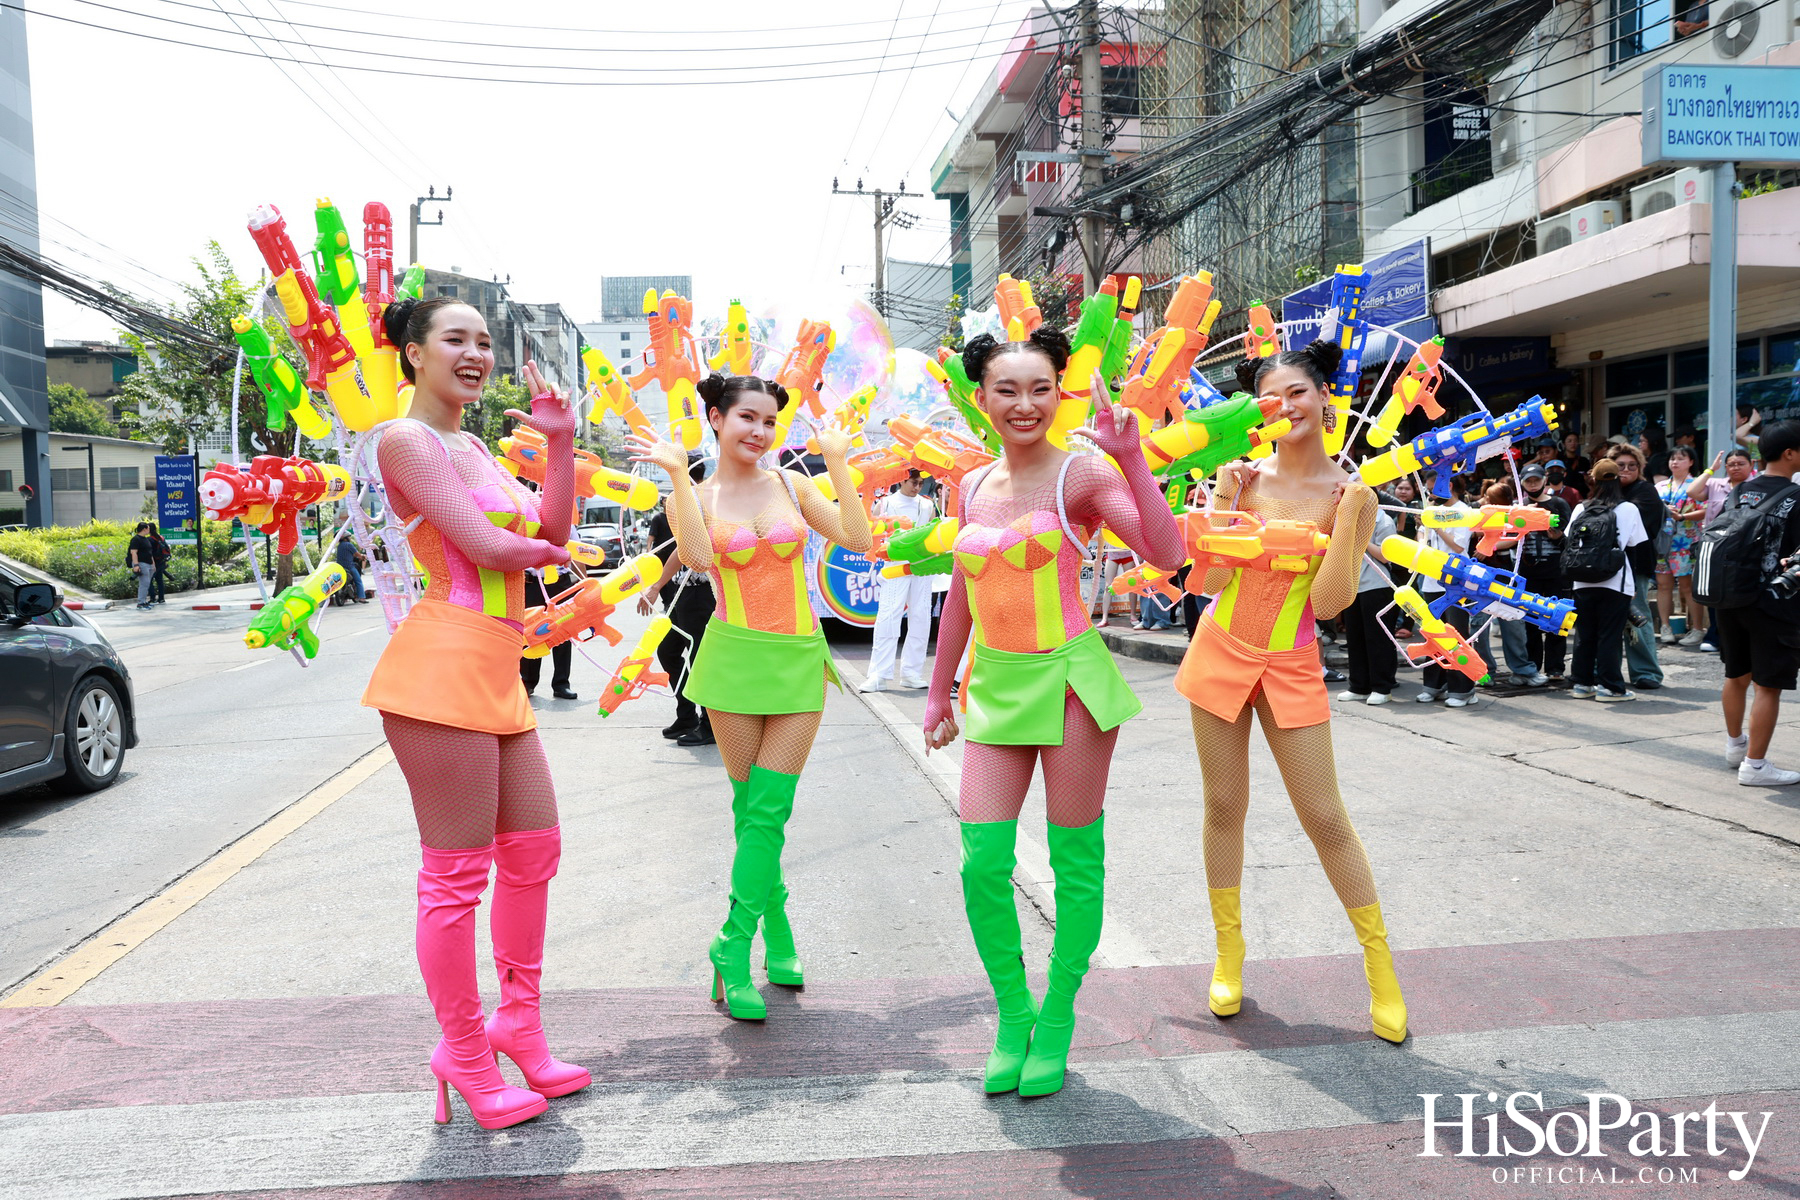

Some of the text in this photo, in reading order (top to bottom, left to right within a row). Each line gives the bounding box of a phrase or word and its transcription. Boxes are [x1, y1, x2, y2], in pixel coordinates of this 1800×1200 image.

[1668, 73, 1707, 89] อาคาร
[1667, 84, 1800, 119] บางกอกไทยทาวเว
[1453, 118, 1481, 128] COFFEE
[1668, 129, 1800, 147] BANGKOK THAI TOW
[1360, 295, 1384, 310] Coffee
[1386, 290, 1393, 302] &
[1395, 282, 1421, 299] Bakery
